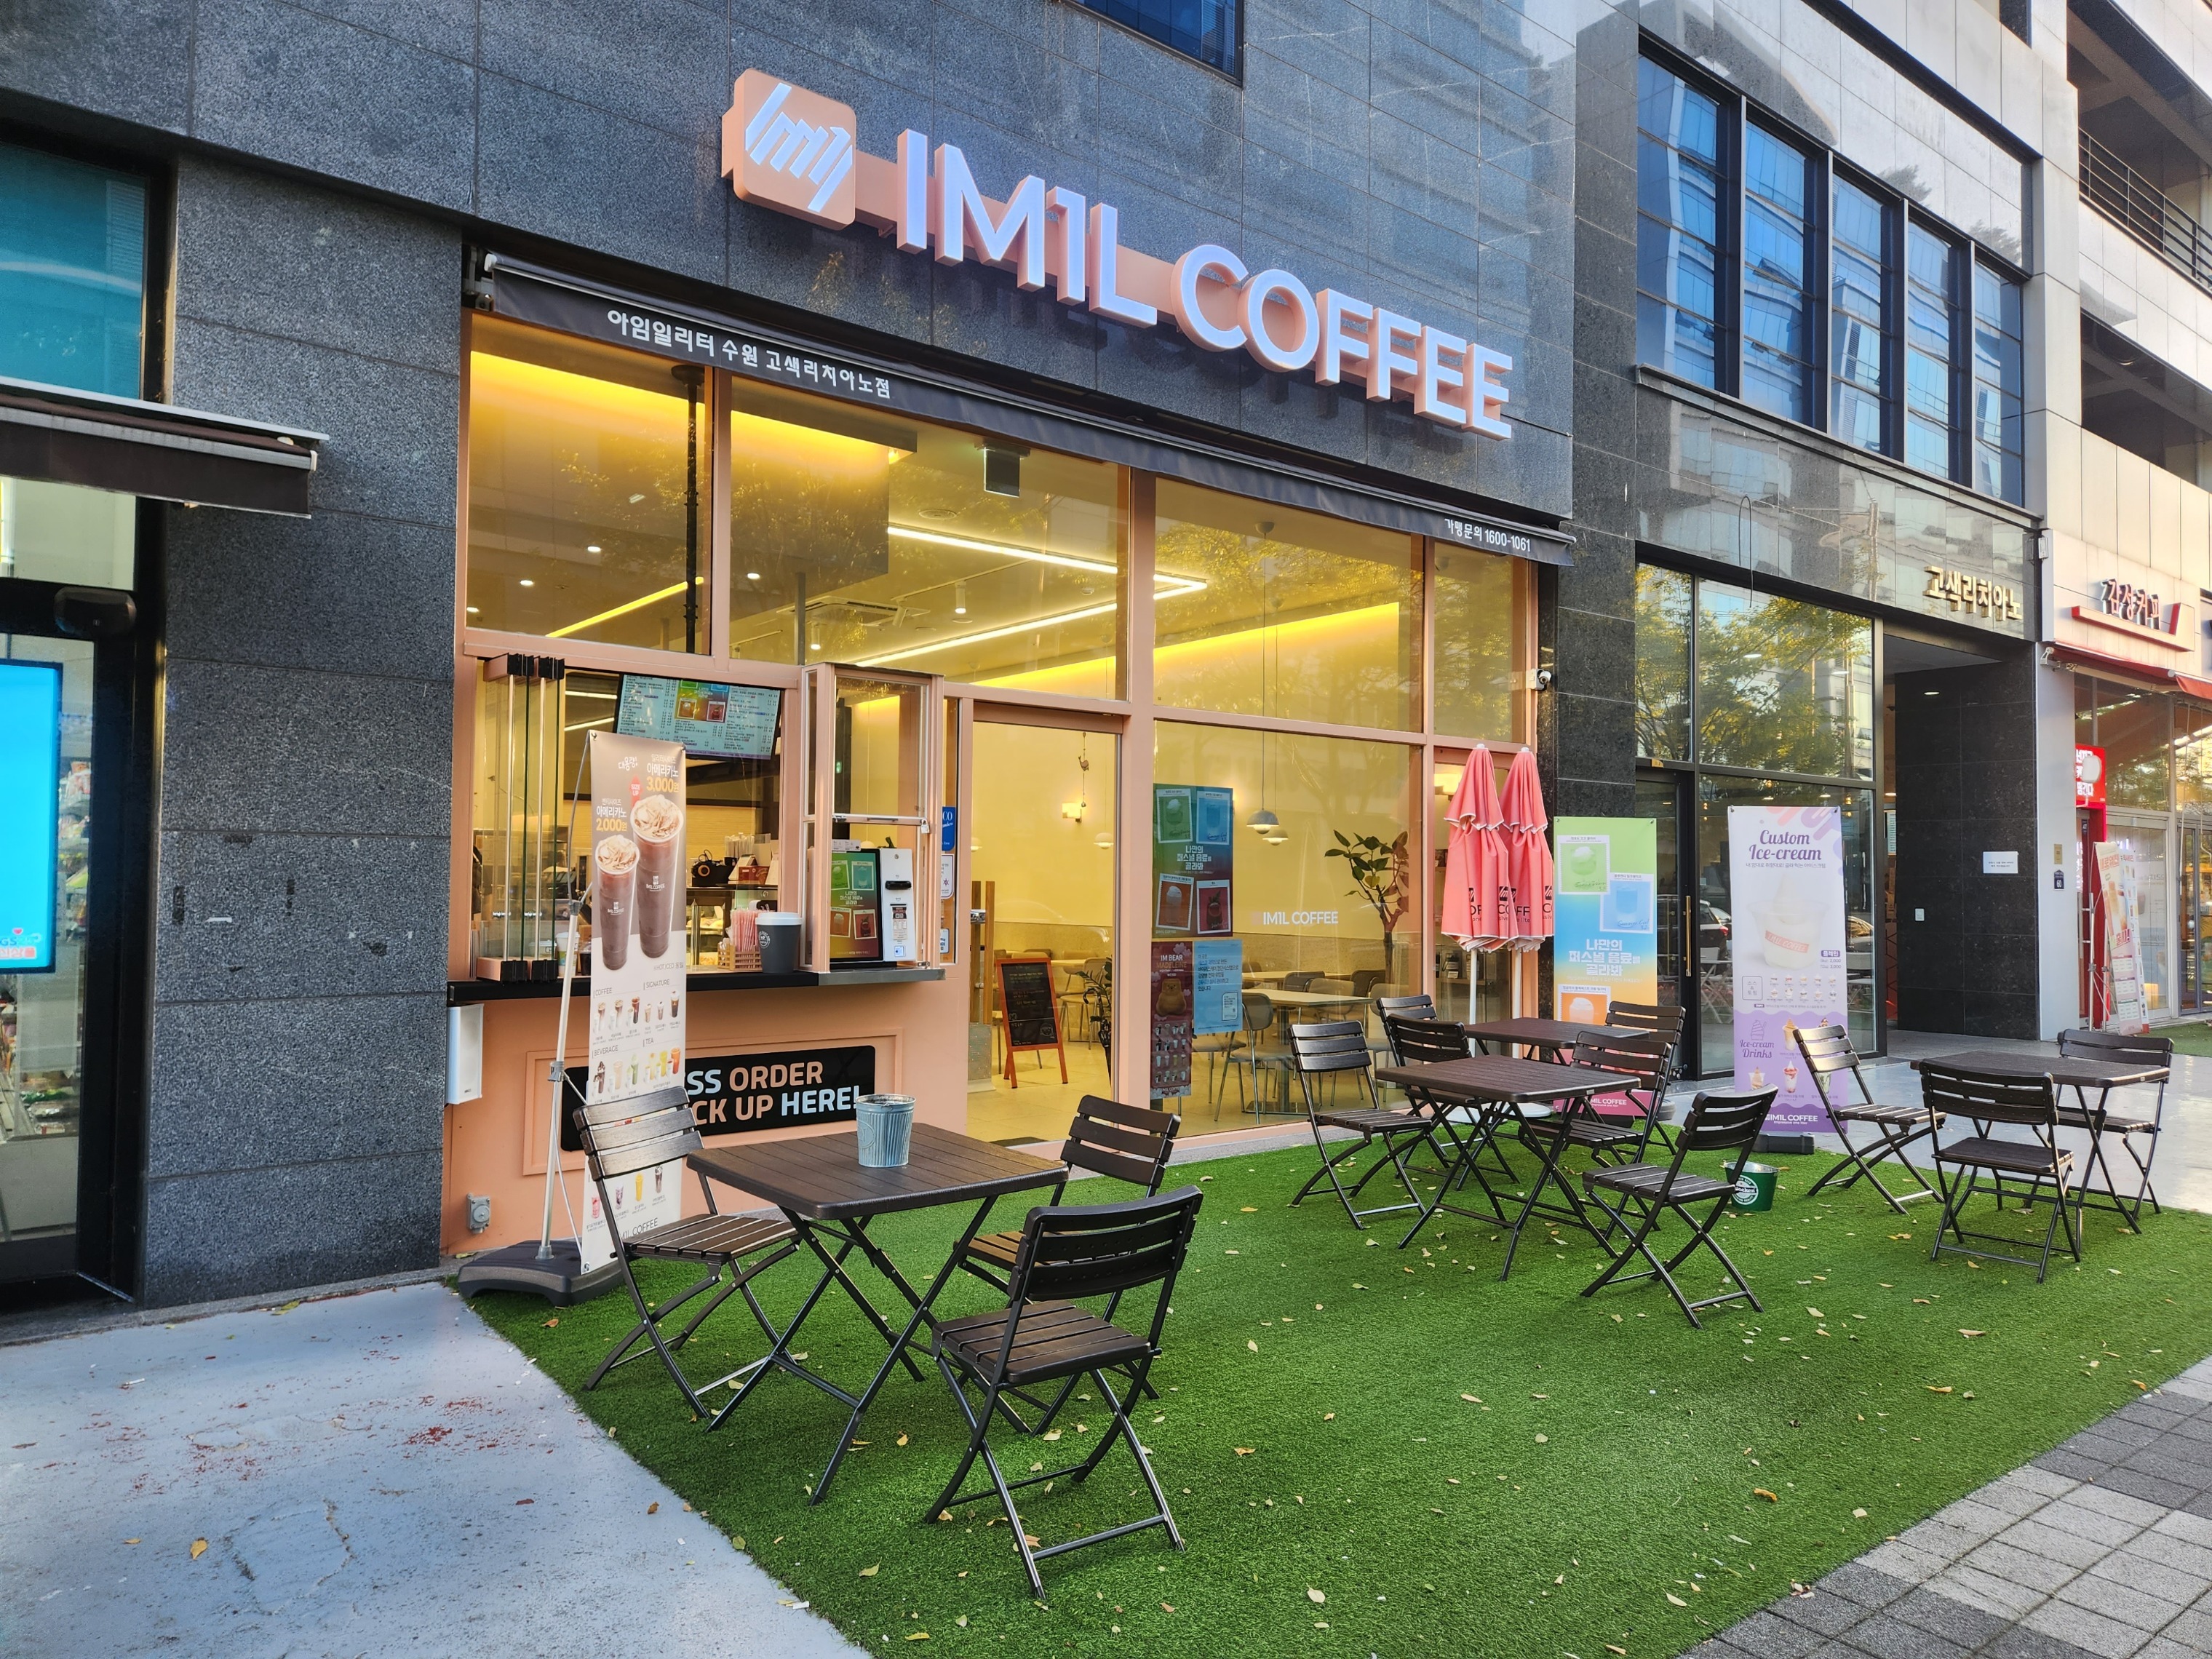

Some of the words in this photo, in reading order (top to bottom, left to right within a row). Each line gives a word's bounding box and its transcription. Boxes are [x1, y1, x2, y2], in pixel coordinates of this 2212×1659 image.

[1172, 244, 1512, 441] COFFEE
[607, 309, 715, 357] 아임일리터
[722, 340, 757, 367] 수원
[765, 349, 891, 399] 고색리치아노점
[1444, 518, 1482, 542] 가맹문의
[1484, 529, 1530, 552] 1600-1061
[1924, 565, 2022, 621] 고색리치아노
[2101, 578, 2160, 630] 감성커피
[647, 763, 679, 777] 아메리카노
[646, 776, 679, 792] 3,000원
[597, 805, 627, 818] 아메리카노
[596, 818, 627, 832] 2,000원
[1760, 830, 1810, 845] Custom
[1185, 846, 1204, 854] 나만의
[1749, 844, 1821, 860] Ice-cream
[1177, 854, 1195, 862] 퍼스널
[2056, 879, 2062, 888] 60
[1292, 911, 1339, 925] COFFEE
[1586, 939, 1622, 951] 나만의
[1569, 950, 1604, 963] 퍼스널
[1608, 952, 1640, 964] 음료를
[1586, 963, 1623, 976] 골라봐
[646, 979, 670, 989] SIGNATURE
[595, 987, 613, 996] COFFEE
[594, 1045, 618, 1057] BEVERAGE
[1740, 1039, 1774, 1049] Ice-cream
[1742, 1049, 1773, 1059] Drinks
[729, 1061, 824, 1091] ORDER
[736, 1094, 773, 1121] UP
[781, 1085, 859, 1116] HERE!
[1788, 1114, 1818, 1122] COFFEE
[632, 1217, 659, 1236] COFFEE
